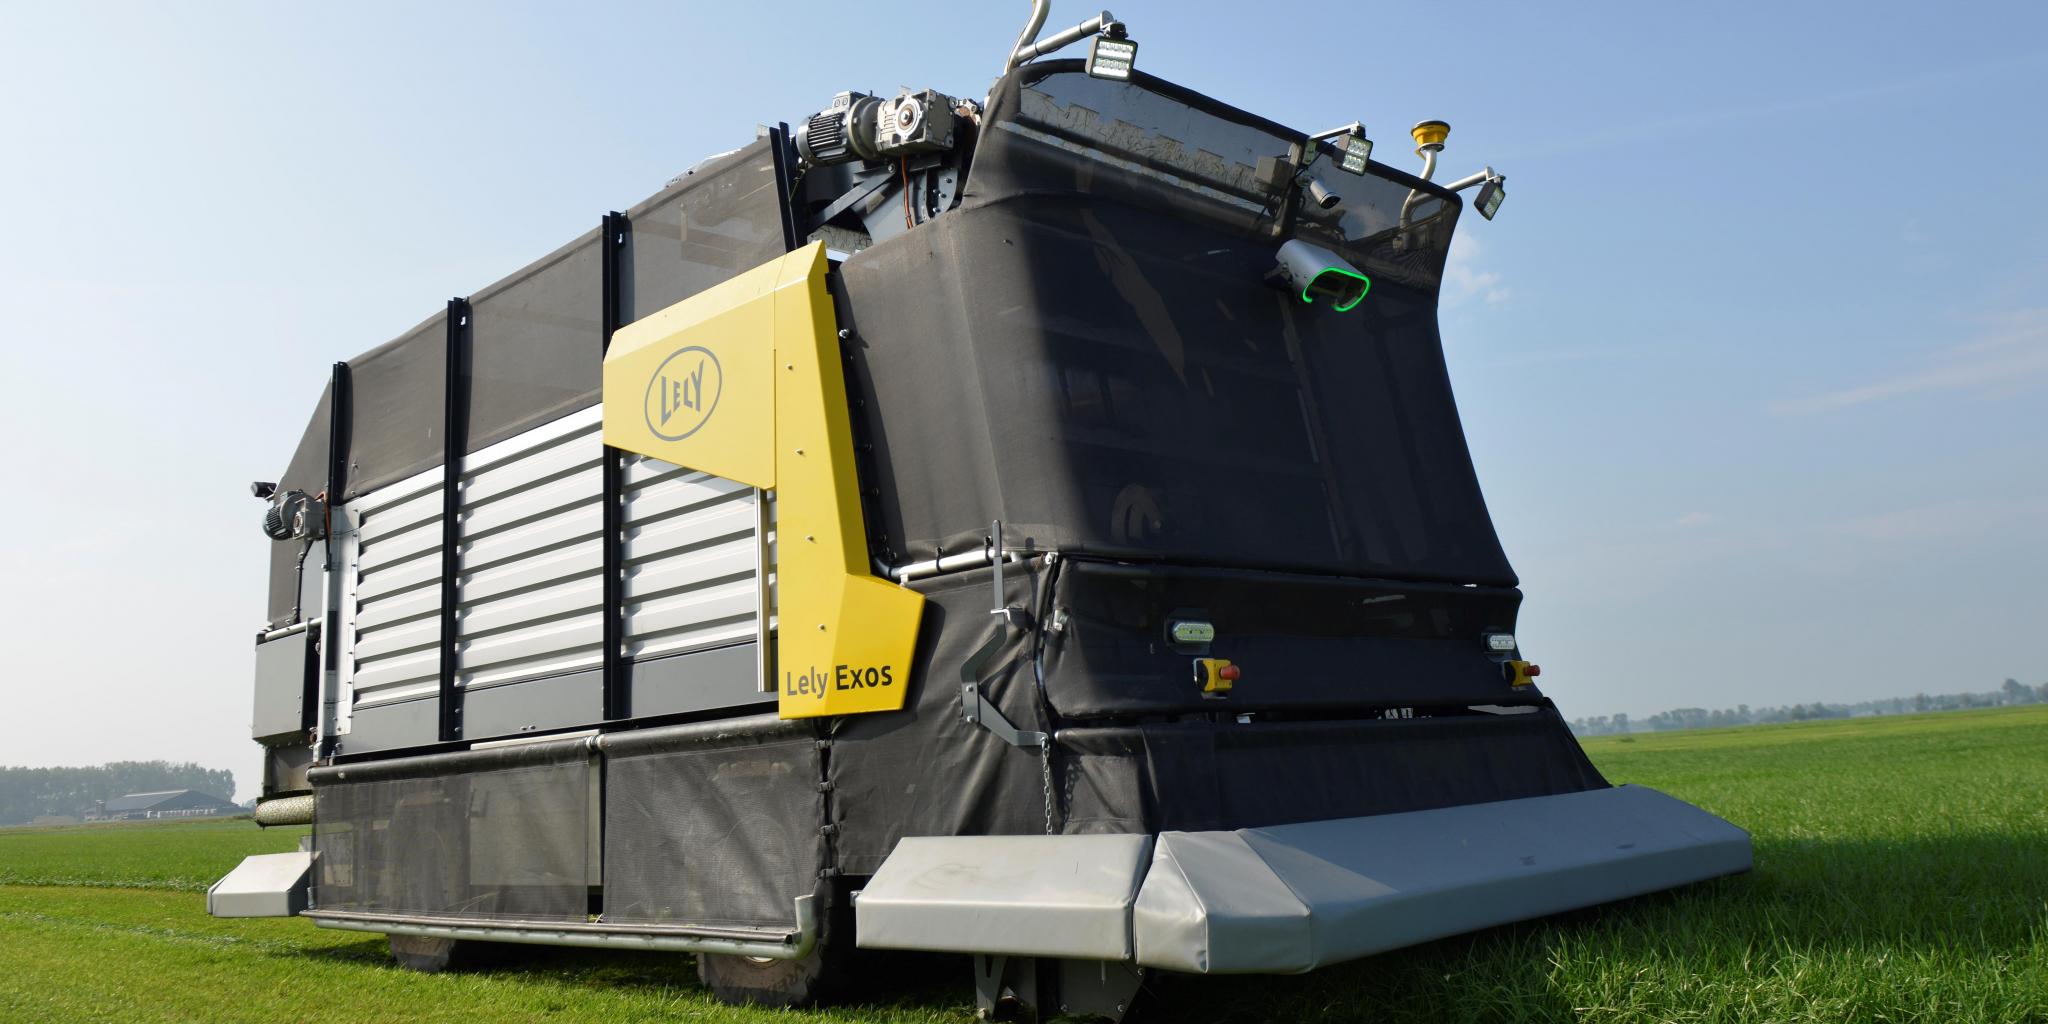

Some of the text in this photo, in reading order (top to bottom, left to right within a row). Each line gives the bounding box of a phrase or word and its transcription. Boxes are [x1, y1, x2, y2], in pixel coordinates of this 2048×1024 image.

[661, 359, 704, 427] LELY
[787, 664, 893, 699] Lely Exos
